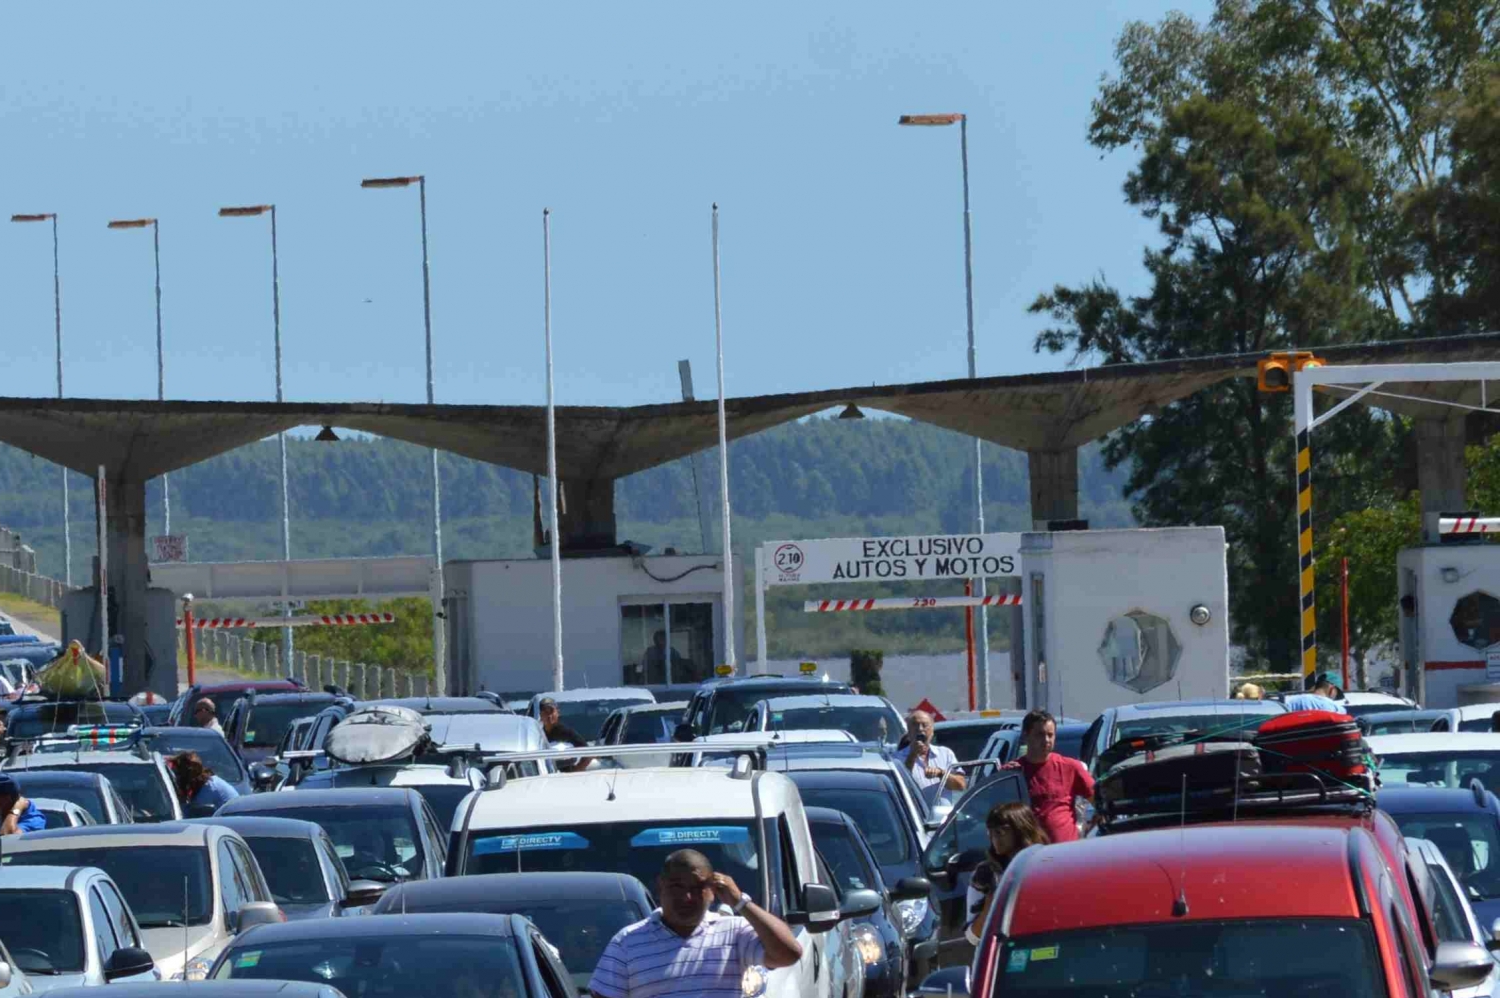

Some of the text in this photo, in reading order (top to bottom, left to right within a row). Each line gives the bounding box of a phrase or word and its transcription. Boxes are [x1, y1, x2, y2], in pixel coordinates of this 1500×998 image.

[862, 537, 984, 558] EXCLUSIVO
[833, 555, 1015, 580] AUTOS Y MOTOS
[520, 836, 562, 845] DIRECTV
[677, 830, 719, 839] DIRECTV
